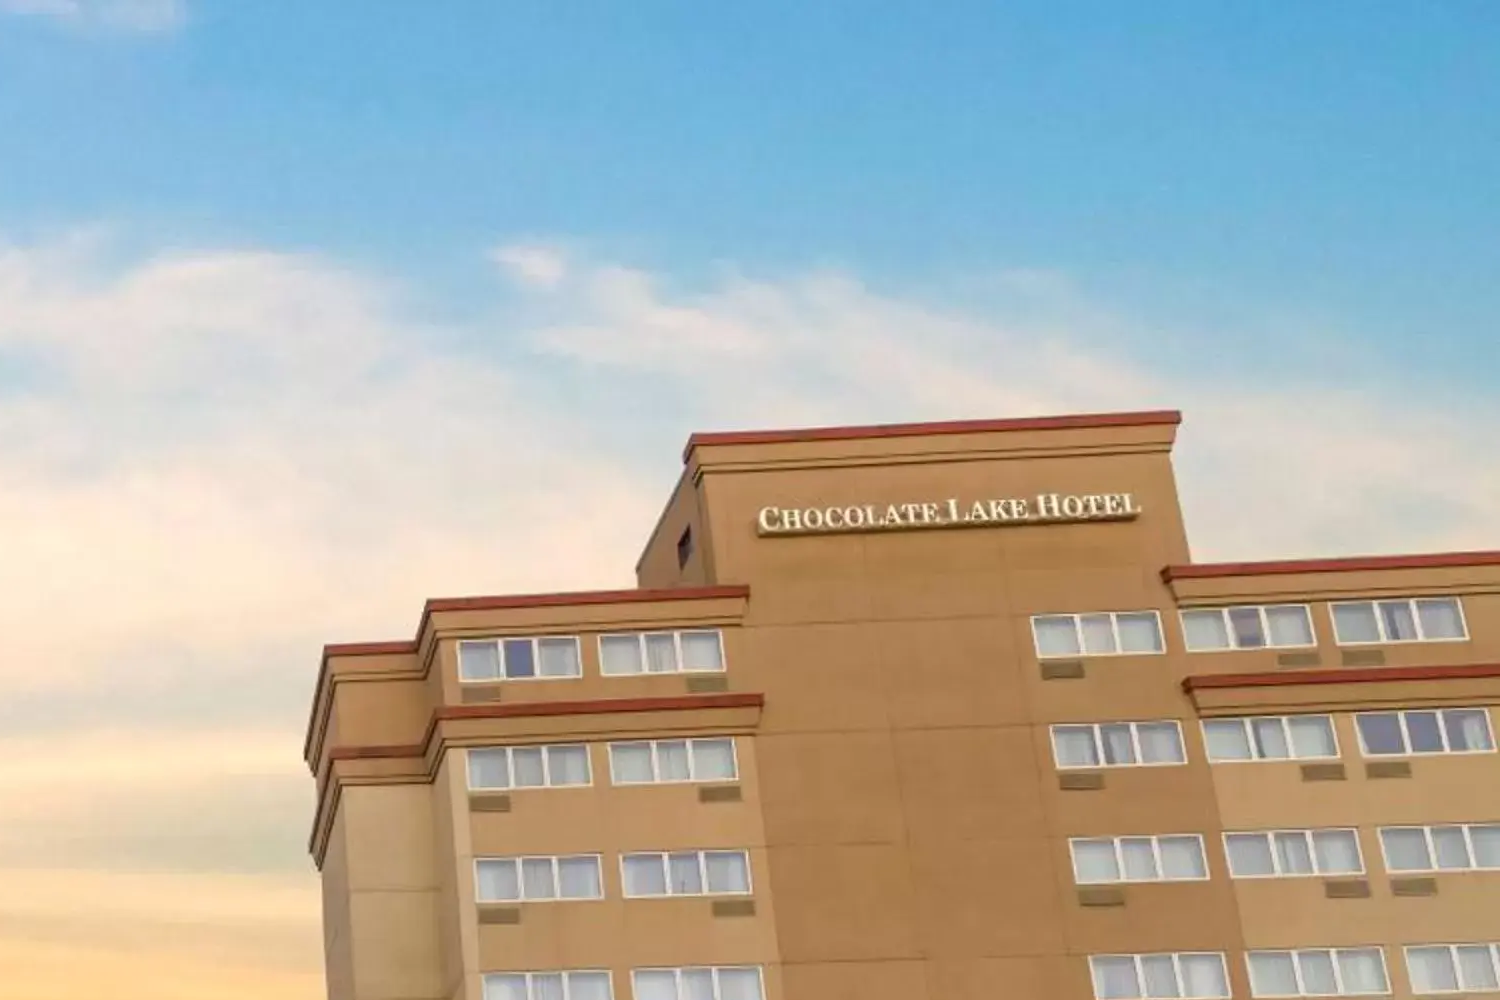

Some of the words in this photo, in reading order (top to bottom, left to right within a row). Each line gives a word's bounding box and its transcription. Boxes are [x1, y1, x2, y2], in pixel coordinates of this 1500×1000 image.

[757, 503, 940, 531] CHOCOLATE
[948, 498, 1028, 522] LAKE
[1036, 493, 1142, 518] HOTEL
